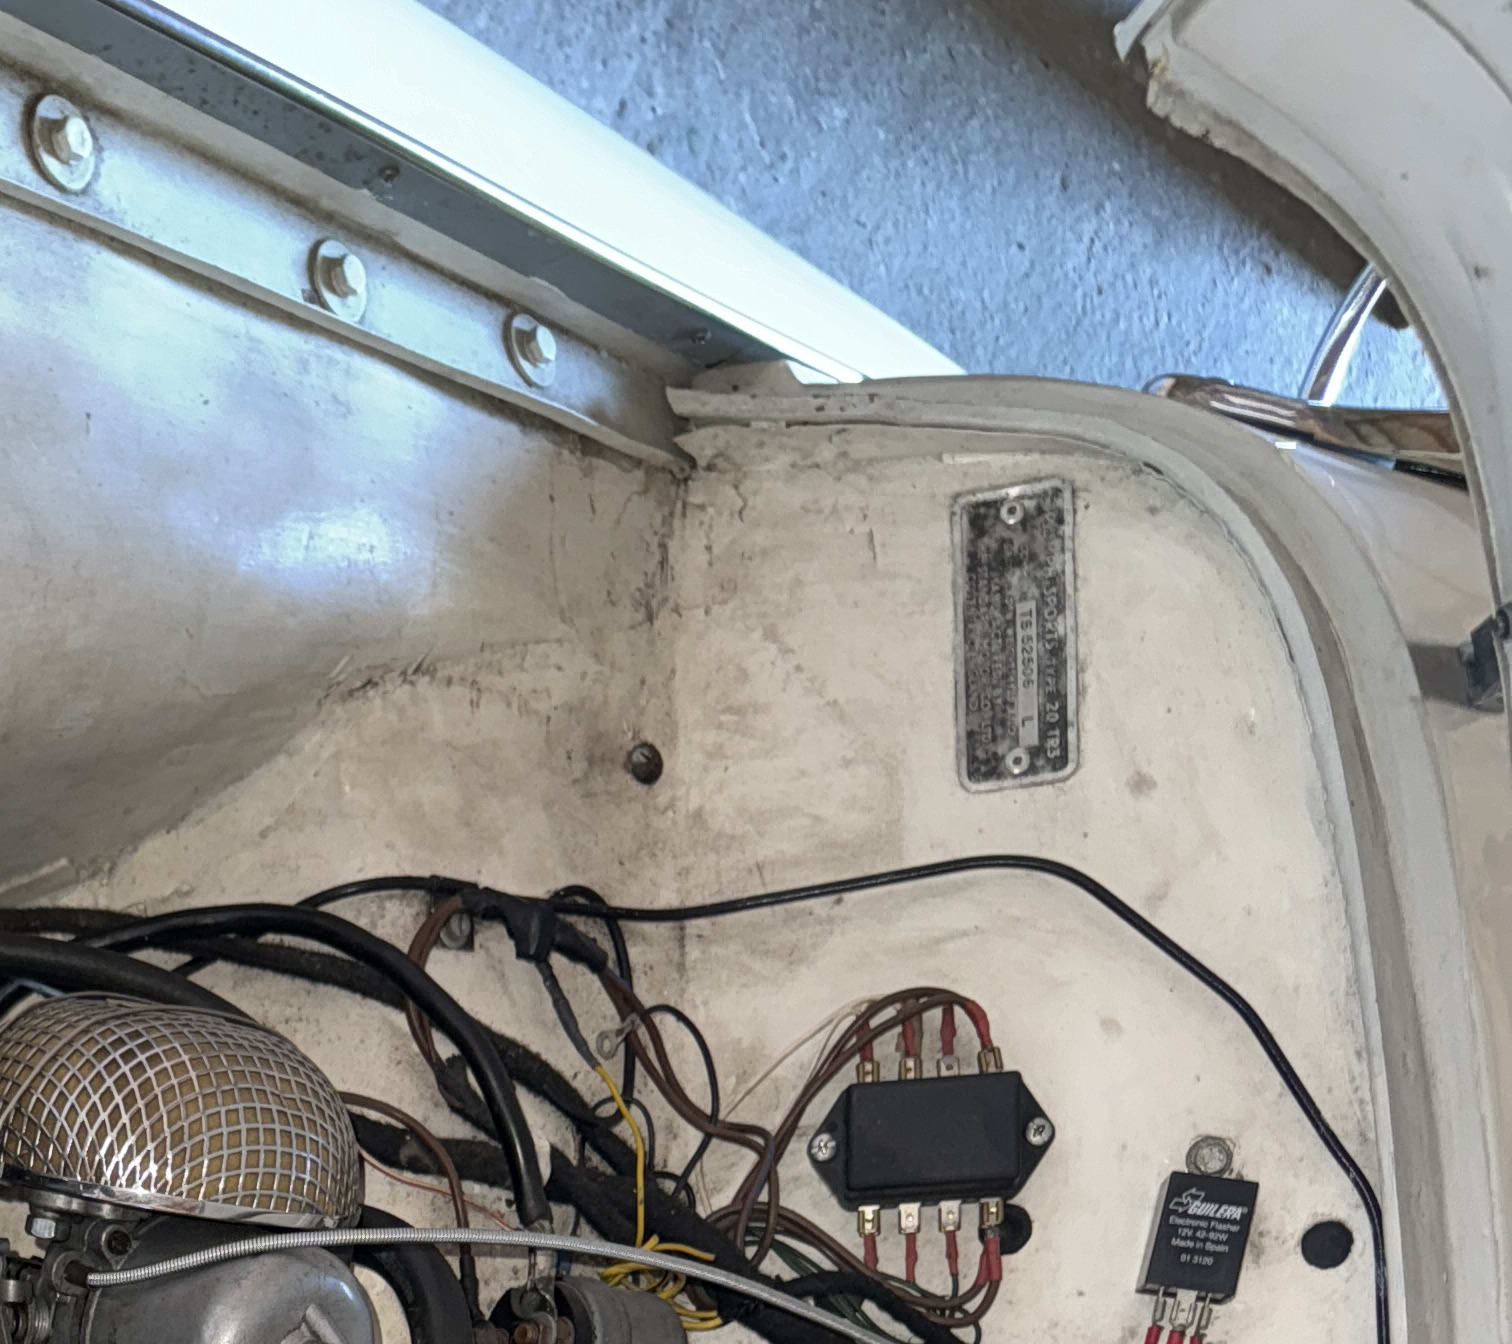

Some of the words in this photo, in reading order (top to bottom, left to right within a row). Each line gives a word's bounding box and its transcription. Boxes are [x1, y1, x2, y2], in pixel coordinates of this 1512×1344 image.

[1021, 715, 1034, 728] L
[1045, 701, 1060, 723] 20
[1046, 728, 1061, 760] TR3
[1189, 1200, 1242, 1221] GUILERA
[1169, 1215, 1208, 1229] Electronic
[1210, 1220, 1240, 1233] Flasher
[1171, 1237, 1194, 1249] Made
[1195, 1240, 1204, 1249] in
[1205, 1241, 1229, 1253] Spain
